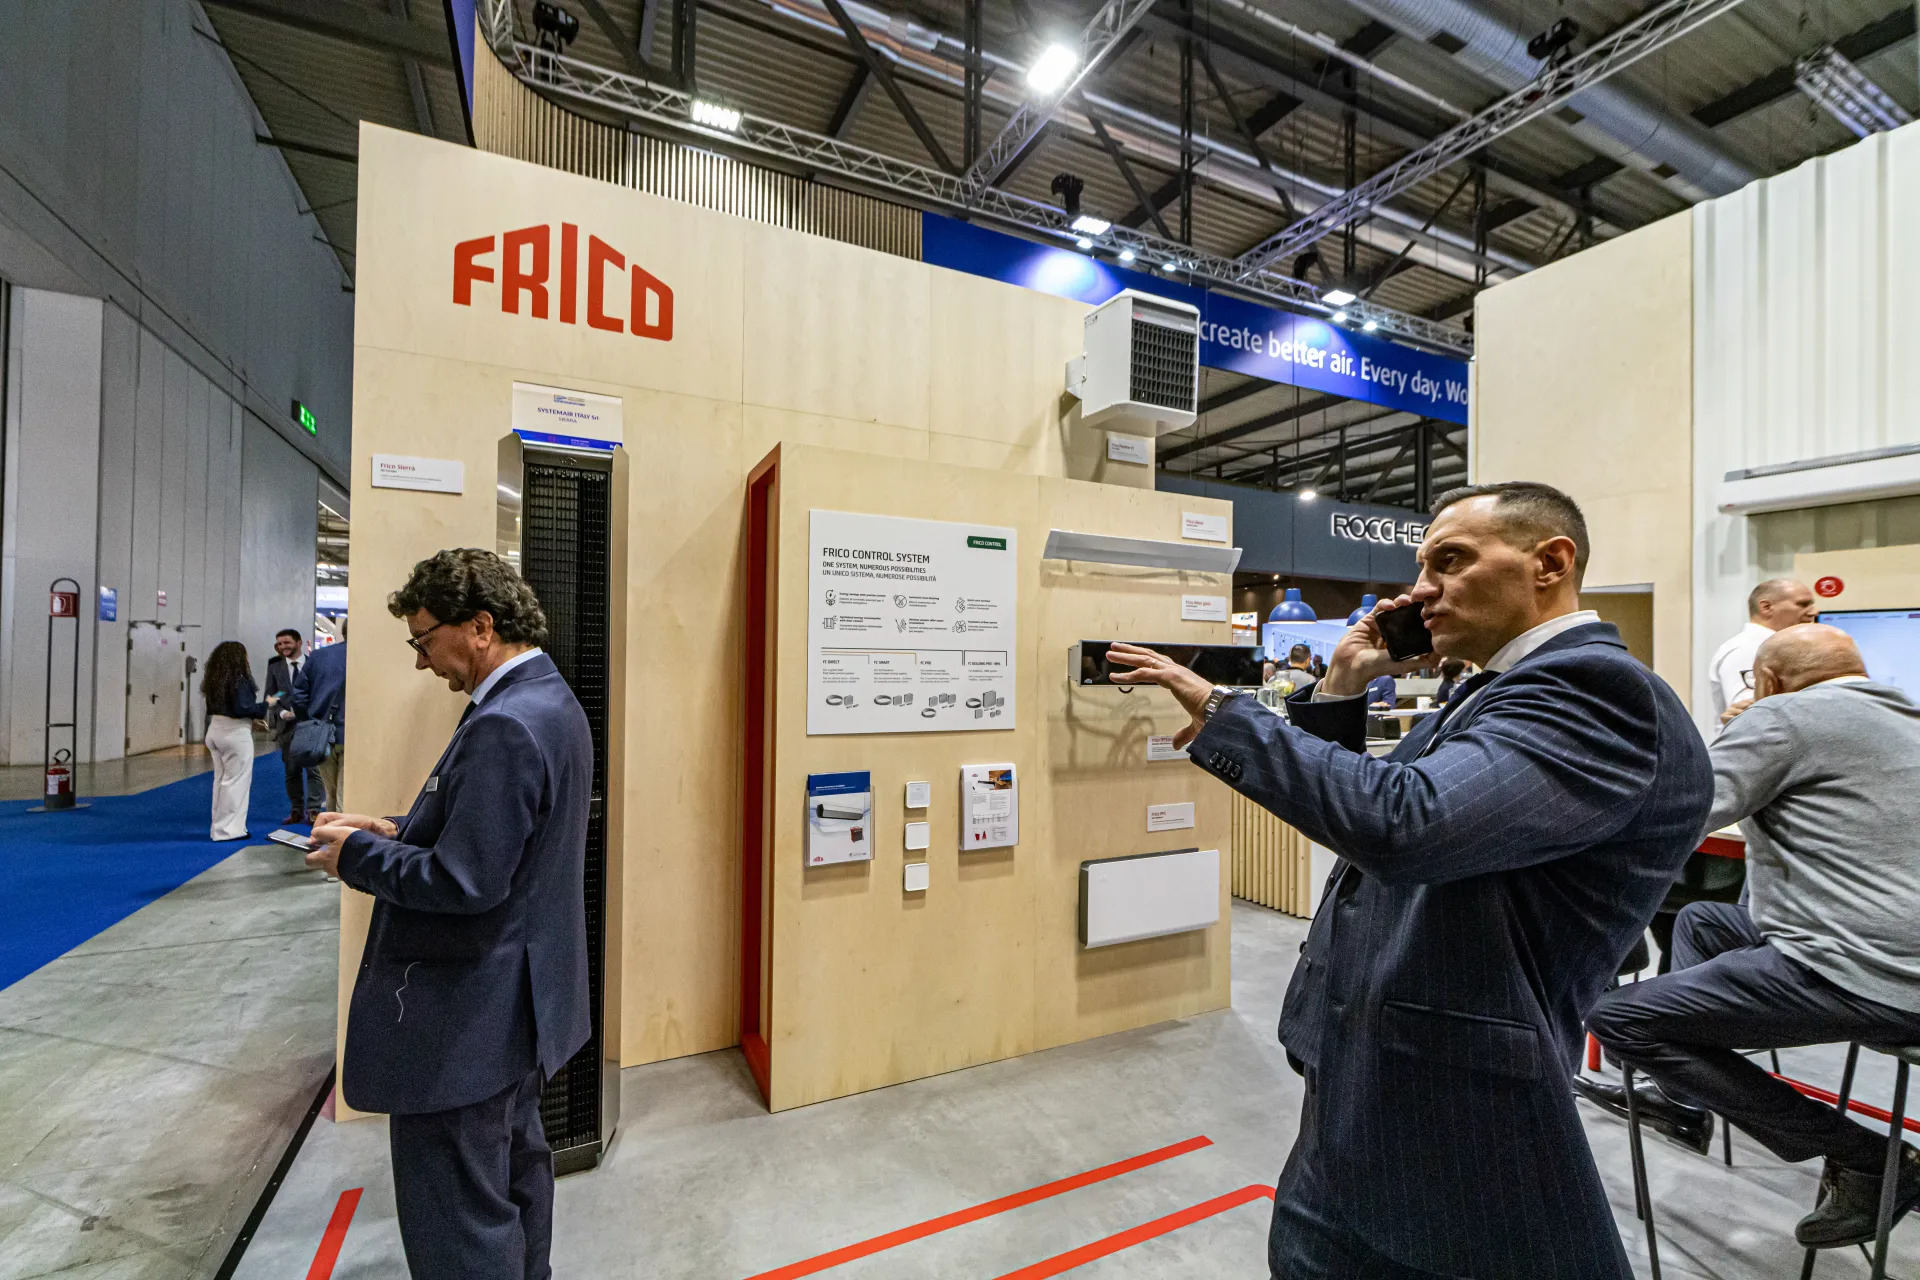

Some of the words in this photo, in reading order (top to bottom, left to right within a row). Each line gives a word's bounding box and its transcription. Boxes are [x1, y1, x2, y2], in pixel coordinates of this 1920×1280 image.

[453, 222, 673, 341] FRICO
[1200, 319, 1262, 353] create
[1269, 332, 1326, 368] better
[1330, 351, 1356, 377] air.
[1361, 357, 1407, 394] Every
[1411, 370, 1442, 403] day.
[538, 407, 573, 417] SYSTEMAIR
[381, 462, 396, 470] Frico
[823, 547, 850, 559] FRICO
[852, 549, 894, 561] CONTROL
[896, 553, 930, 564] SYSTEM
[835, 562, 859, 570] SYSTEM,
[860, 563, 890, 572] NUMEROUS
[890, 565, 926, 574] POSSIBILITIES
[850, 571, 875, 579] SISTEMA,
[906, 574, 937, 582] POSSIBILITÀ
